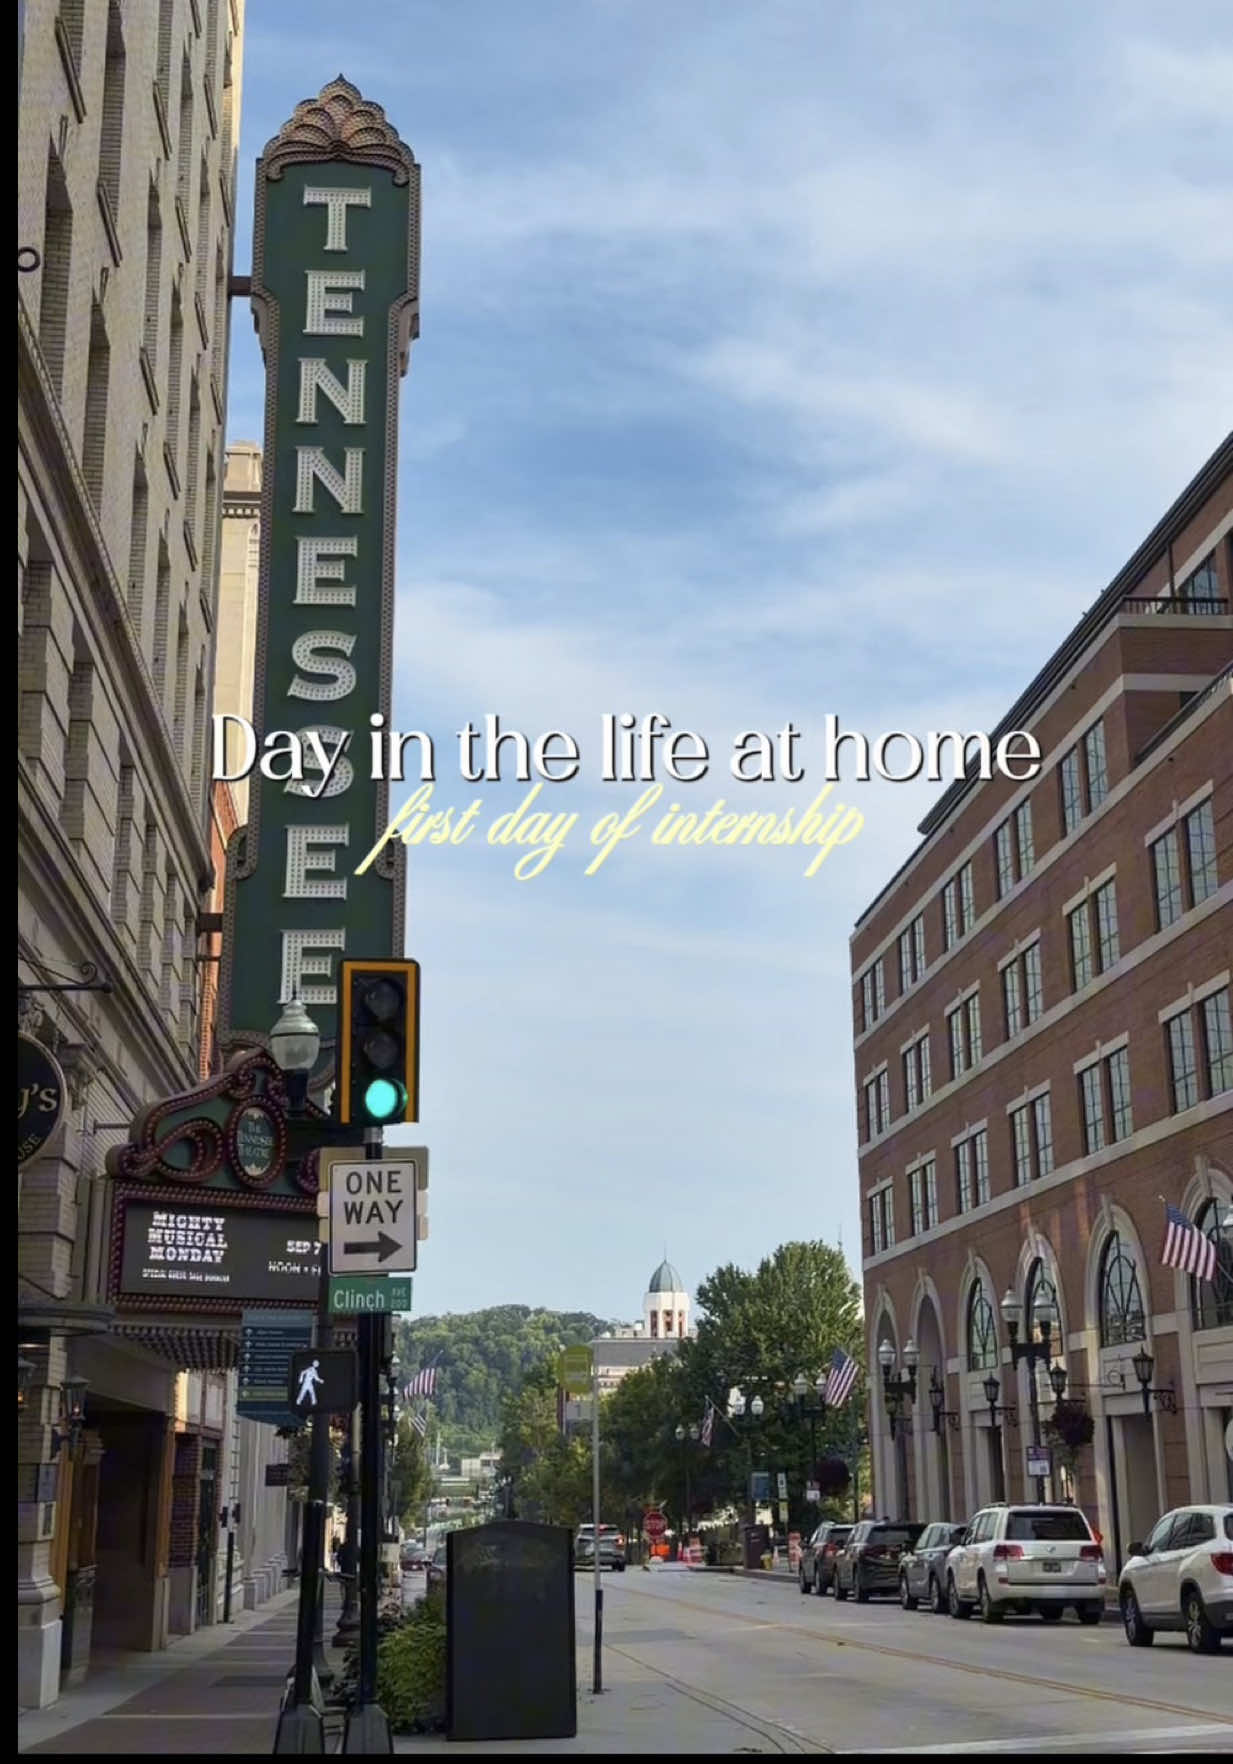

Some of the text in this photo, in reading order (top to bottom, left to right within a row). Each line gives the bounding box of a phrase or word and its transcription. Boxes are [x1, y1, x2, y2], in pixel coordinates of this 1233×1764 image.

[277, 185, 372, 1005] TENNESSEE
[345, 1170, 403, 1195] ONE
[152, 1211, 226, 1232] MIGHTY
[344, 1200, 404, 1225] WAY
[147, 1228, 229, 1249] MUSICAL
[286, 1240, 311, 1253] SEP
[149, 1246, 225, 1263] MONDAY
[333, 1288, 385, 1310] Clinch
